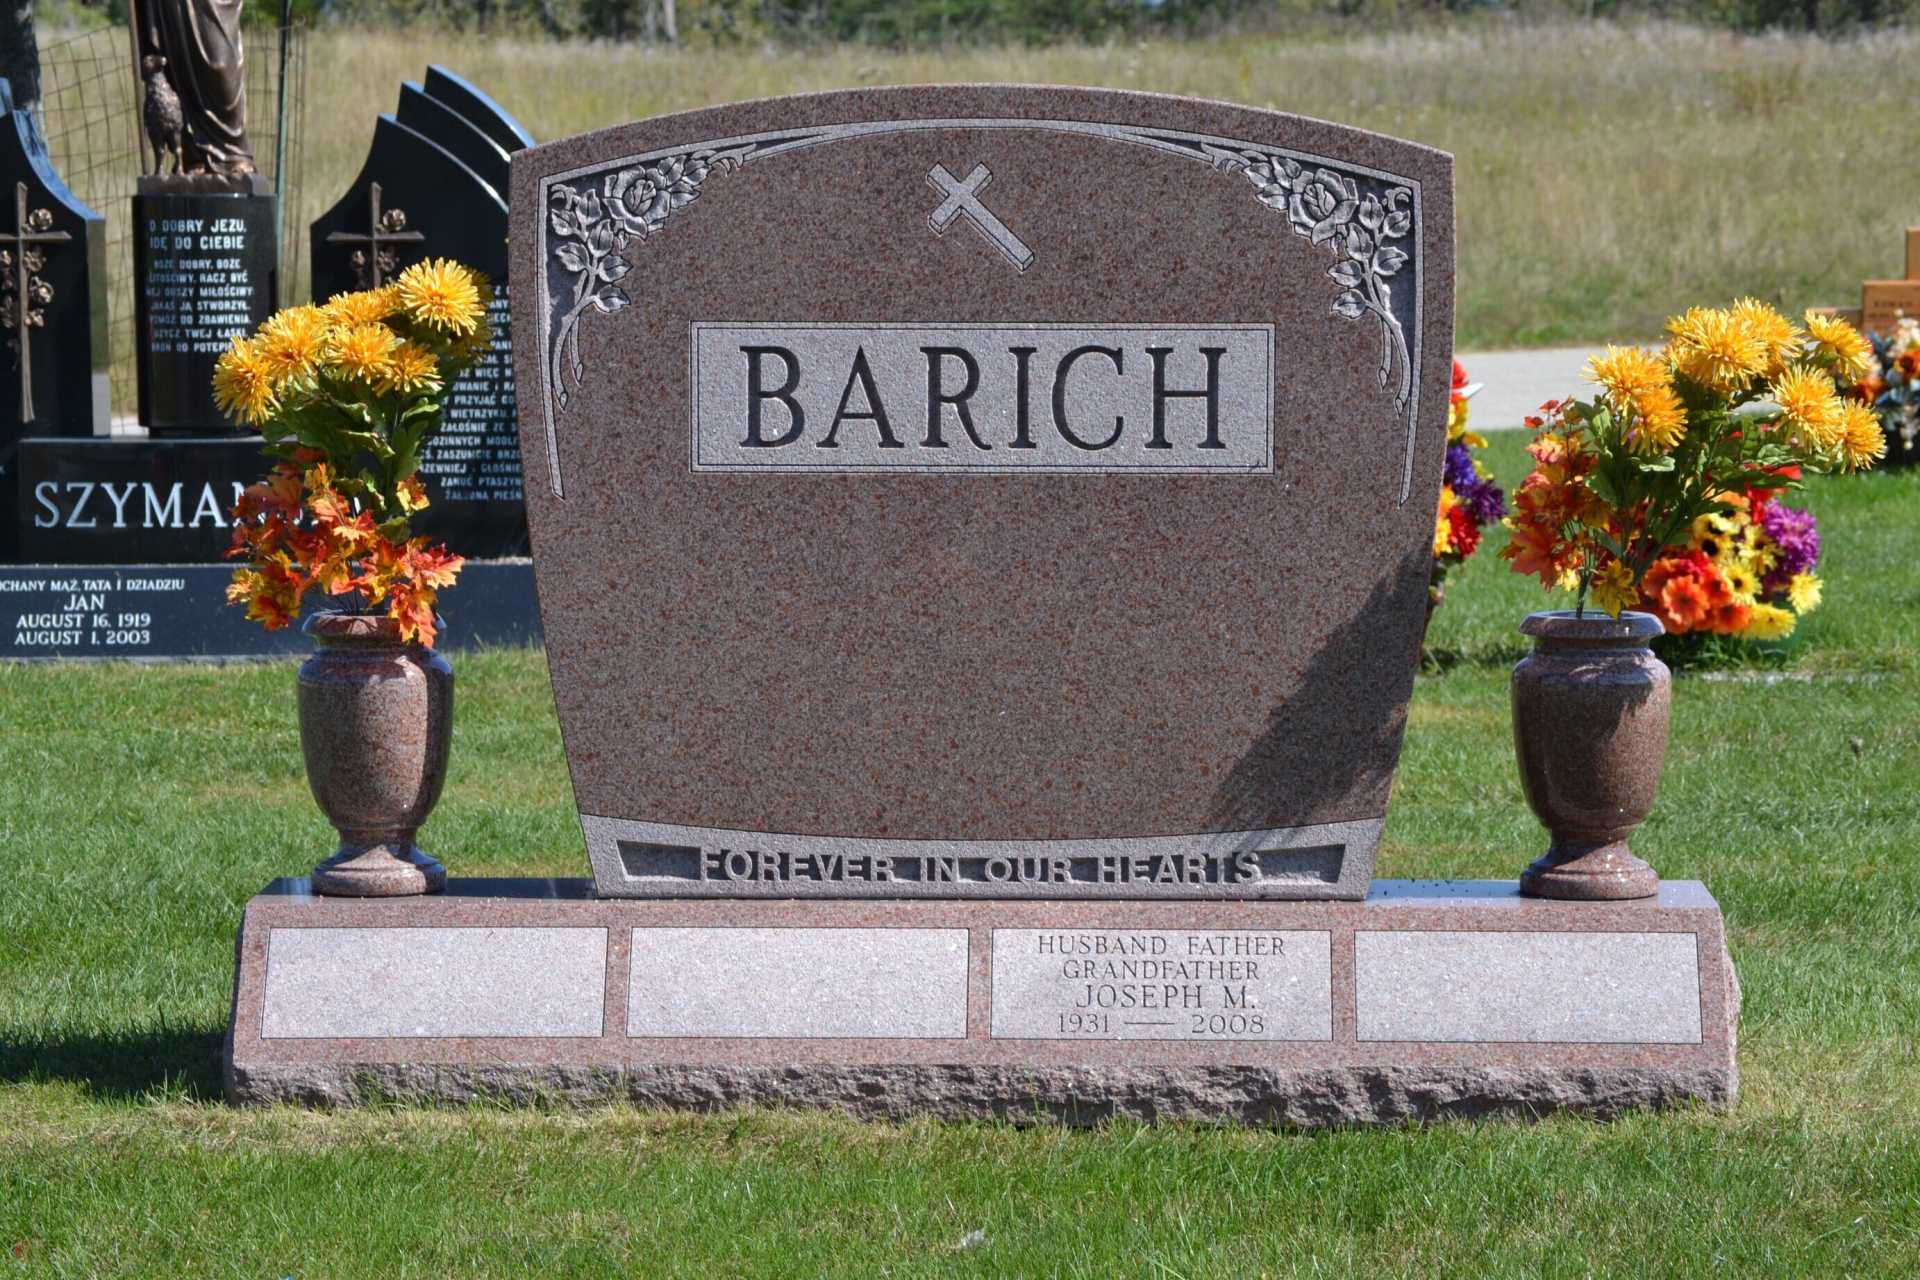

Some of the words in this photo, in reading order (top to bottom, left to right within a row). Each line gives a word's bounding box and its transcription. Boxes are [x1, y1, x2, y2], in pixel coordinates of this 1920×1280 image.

[162, 219, 203, 232] DOBRY
[175, 236, 192, 249] DO
[200, 235, 244, 250] CIEBIE
[739, 345, 1227, 451] BARICH
[84, 580, 112, 591] TATA
[126, 579, 185, 591] DZIADZIU
[64, 593, 105, 611] JAN
[16, 614, 84, 628] AUGUST
[118, 613, 151, 628] 1919
[14, 631, 82, 645] AUGUST
[106, 630, 150, 645] 2003
[702, 850, 895, 883] FOREVER
[920, 857, 960, 883] IN
[984, 857, 1073, 883] OUR
[1099, 851, 1261, 884] HEARTS
[1038, 935, 1167, 955] HUSBAND
[1188, 936, 1285, 955] FATHER
[1063, 960, 1259, 980] GRANDFATHER
[1075, 984, 1202, 1008] JOSEPH
[1223, 985, 1256, 1009] M.
[1059, 1013, 1109, 1033] 1931
[1191, 1014, 1265, 1034] 2008
